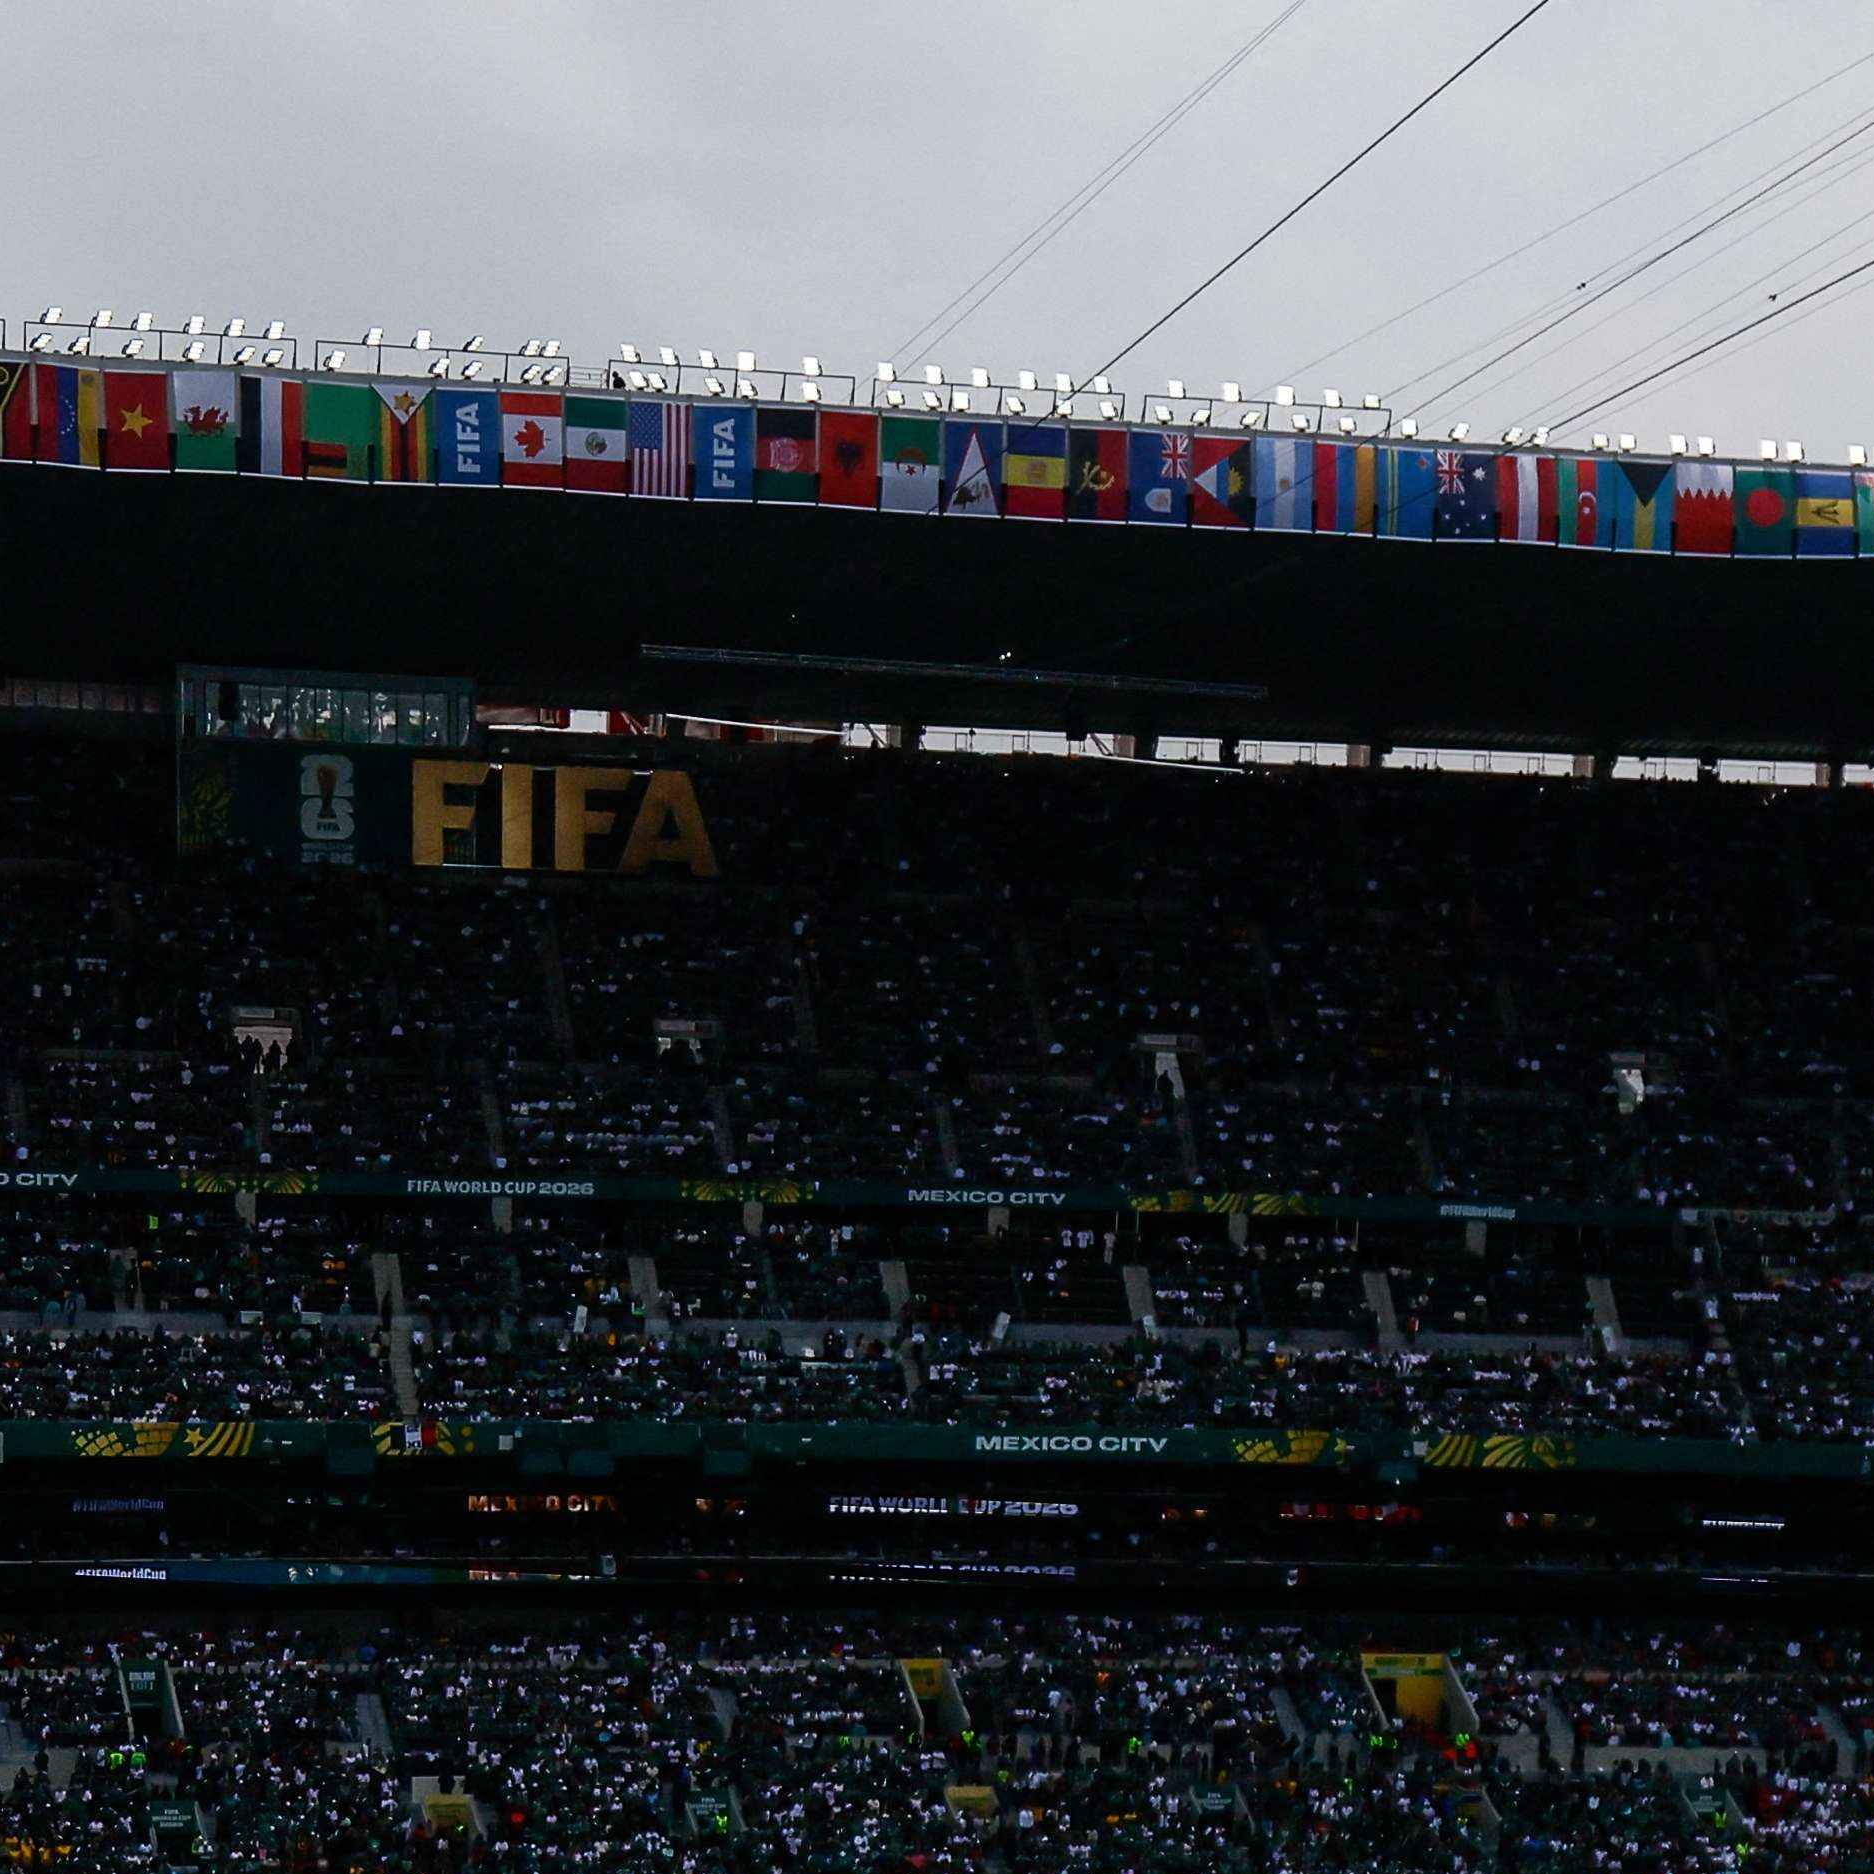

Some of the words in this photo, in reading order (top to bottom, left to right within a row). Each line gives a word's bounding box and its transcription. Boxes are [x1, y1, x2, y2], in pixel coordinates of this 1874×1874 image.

[455, 402, 480, 473] FIFA
[712, 418, 735, 488] FIFA
[413, 758, 720, 876] FIFA
[15, 1173, 78, 1186] CITY
[407, 1180, 442, 1193] FIFA
[443, 1180, 501, 1194] WORLD
[504, 1181, 536, 1194] CUP
[539, 1182, 595, 1196] 2026
[908, 1189, 1005, 1203] MEXICO
[1009, 1191, 1066, 1205] CITY
[975, 1436, 1093, 1451] MEXICO
[1098, 1436, 1168, 1453] CITY
[829, 1497, 875, 1513] FIFA
[1005, 1501, 1079, 1515] 2026
